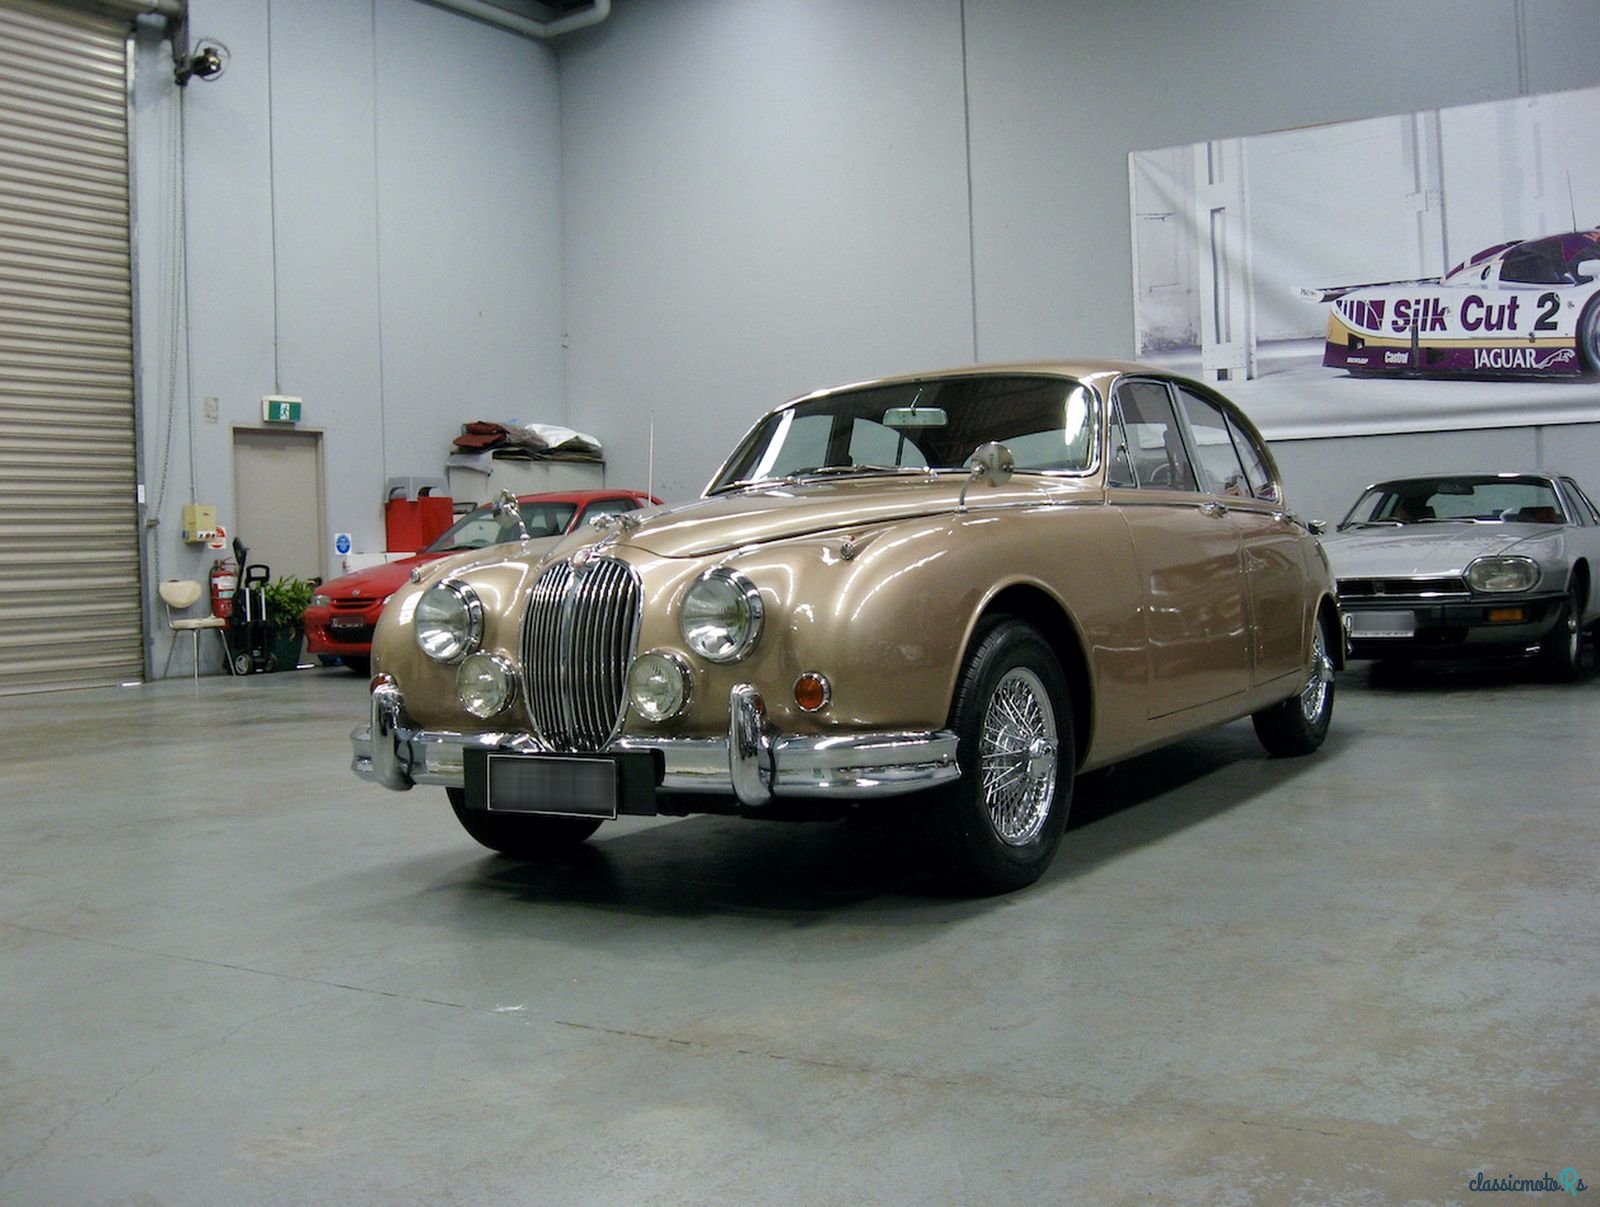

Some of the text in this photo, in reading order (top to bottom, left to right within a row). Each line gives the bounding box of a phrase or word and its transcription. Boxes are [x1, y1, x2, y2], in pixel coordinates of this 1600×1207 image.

[1391, 292, 1560, 333] Silk Cut 2
[1474, 348, 1537, 369] JAGUAR
